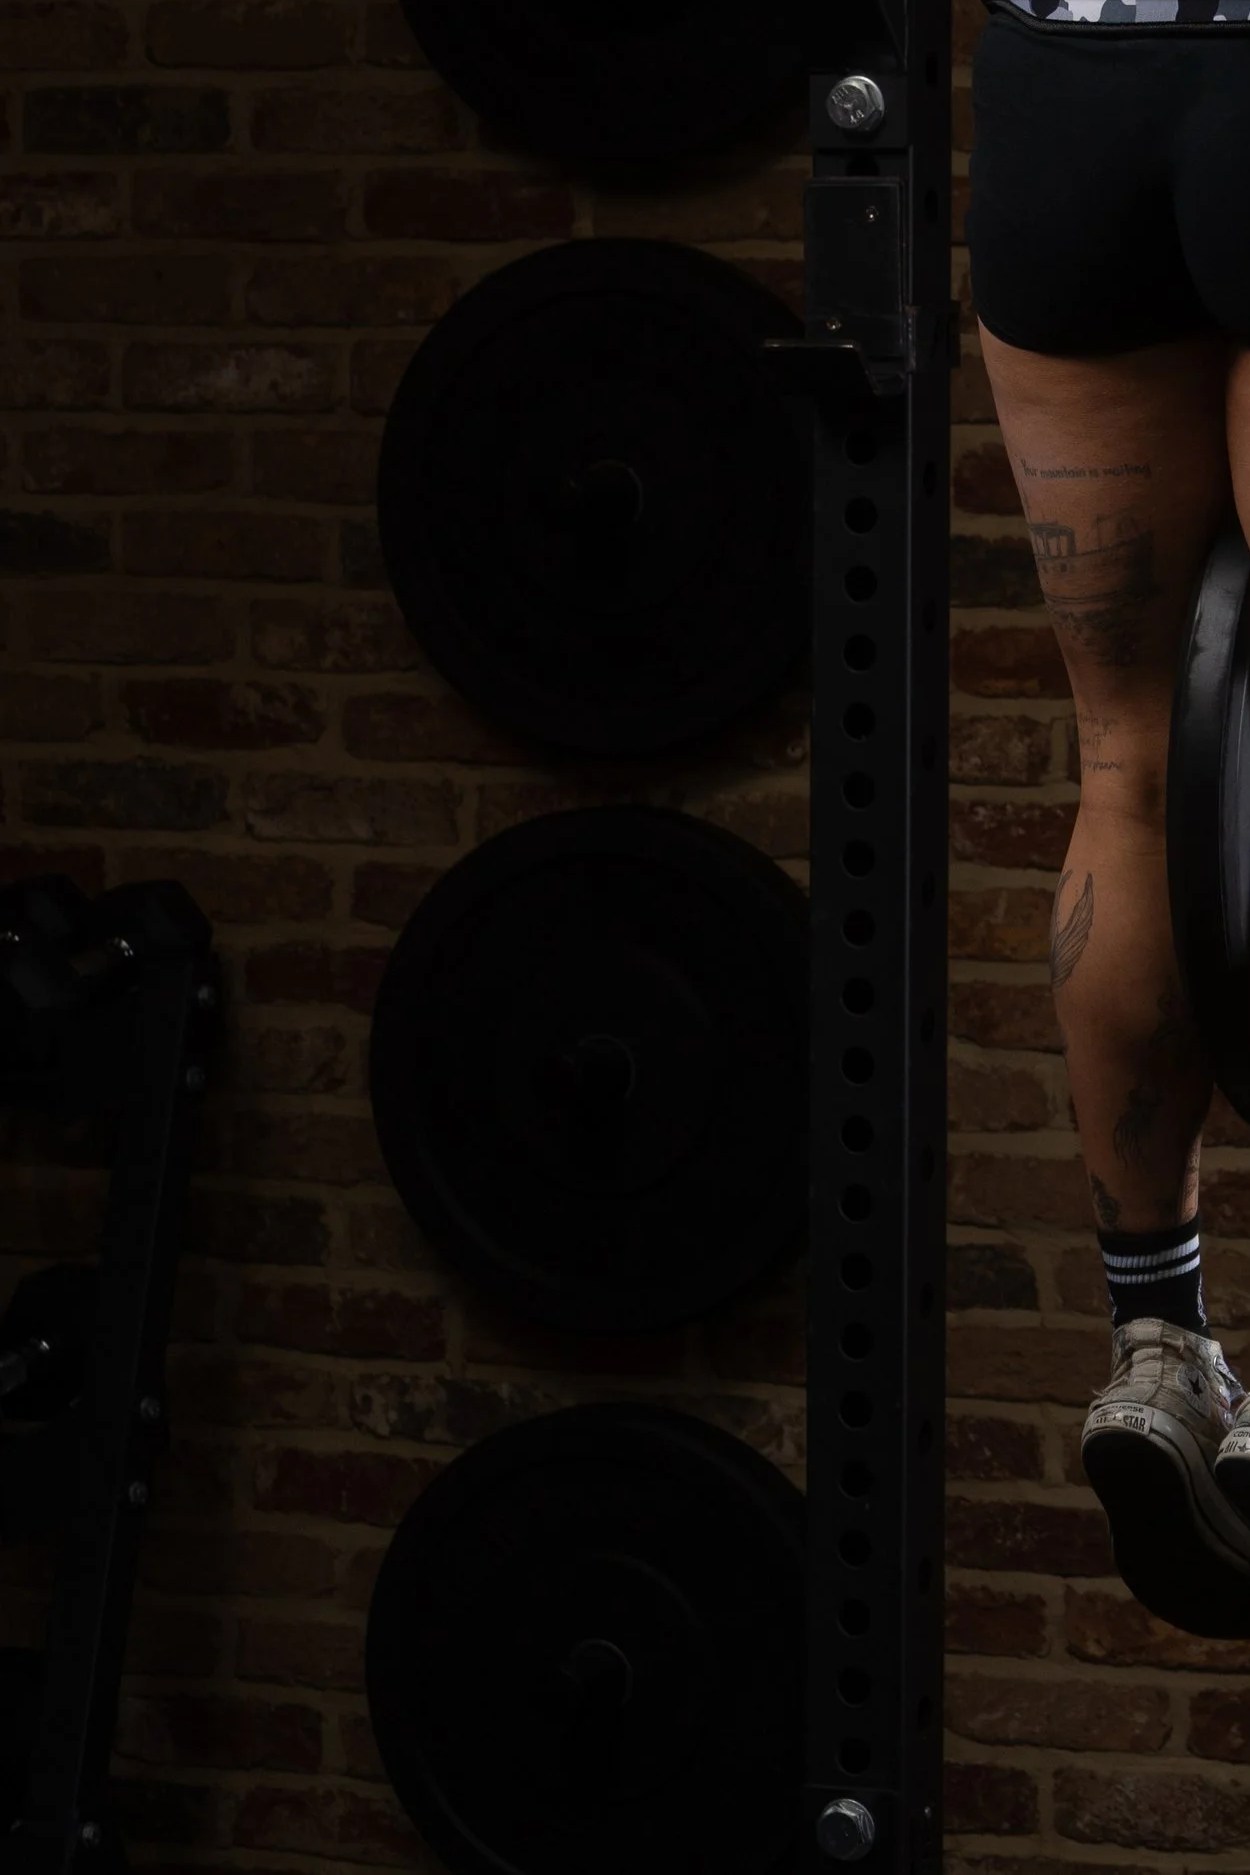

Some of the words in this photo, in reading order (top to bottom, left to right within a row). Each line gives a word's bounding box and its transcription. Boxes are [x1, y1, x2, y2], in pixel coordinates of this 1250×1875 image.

[1040, 467, 1087, 479] mountain
[1103, 463, 1151, 479] waiting
[1123, 1415, 1146, 1432] STAR
